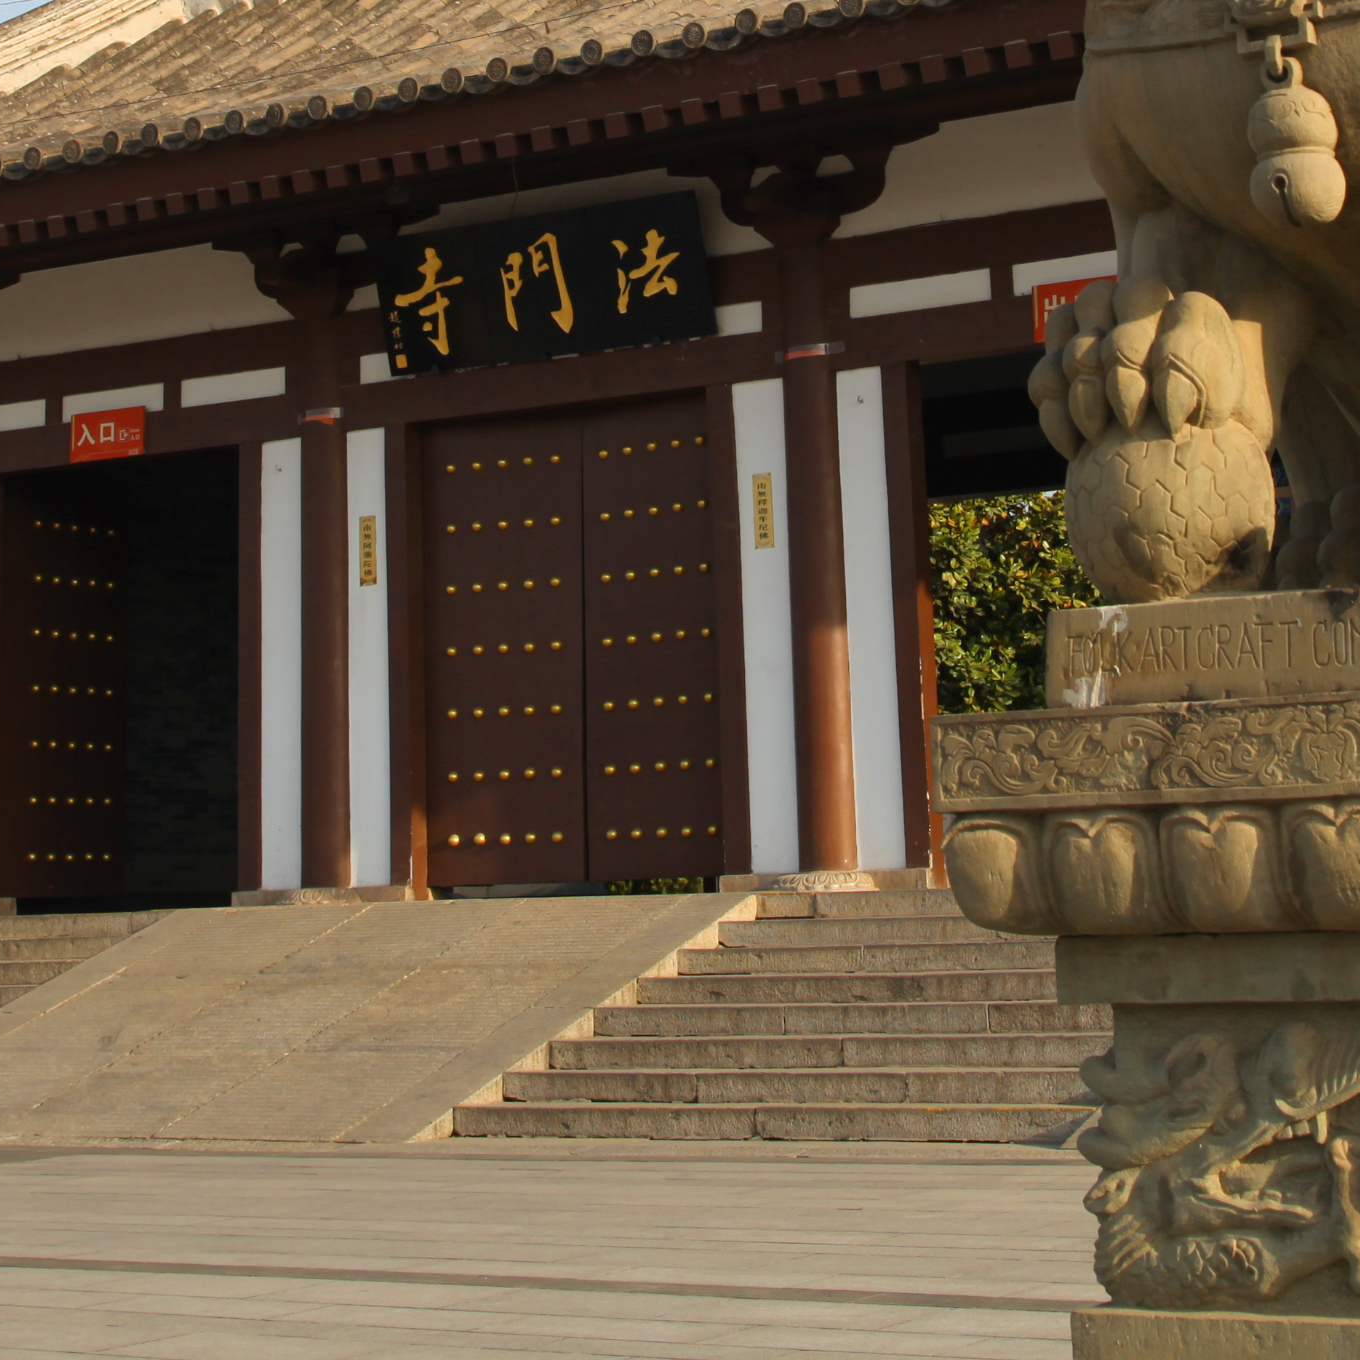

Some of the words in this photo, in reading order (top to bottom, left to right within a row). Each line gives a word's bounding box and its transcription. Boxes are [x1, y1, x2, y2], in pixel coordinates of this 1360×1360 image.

[77, 422, 115, 446] 入口
[1065, 629, 1134, 678] FOLK
[1138, 625, 1192, 673] ART
[1196, 620, 1299, 672] CRAFT
